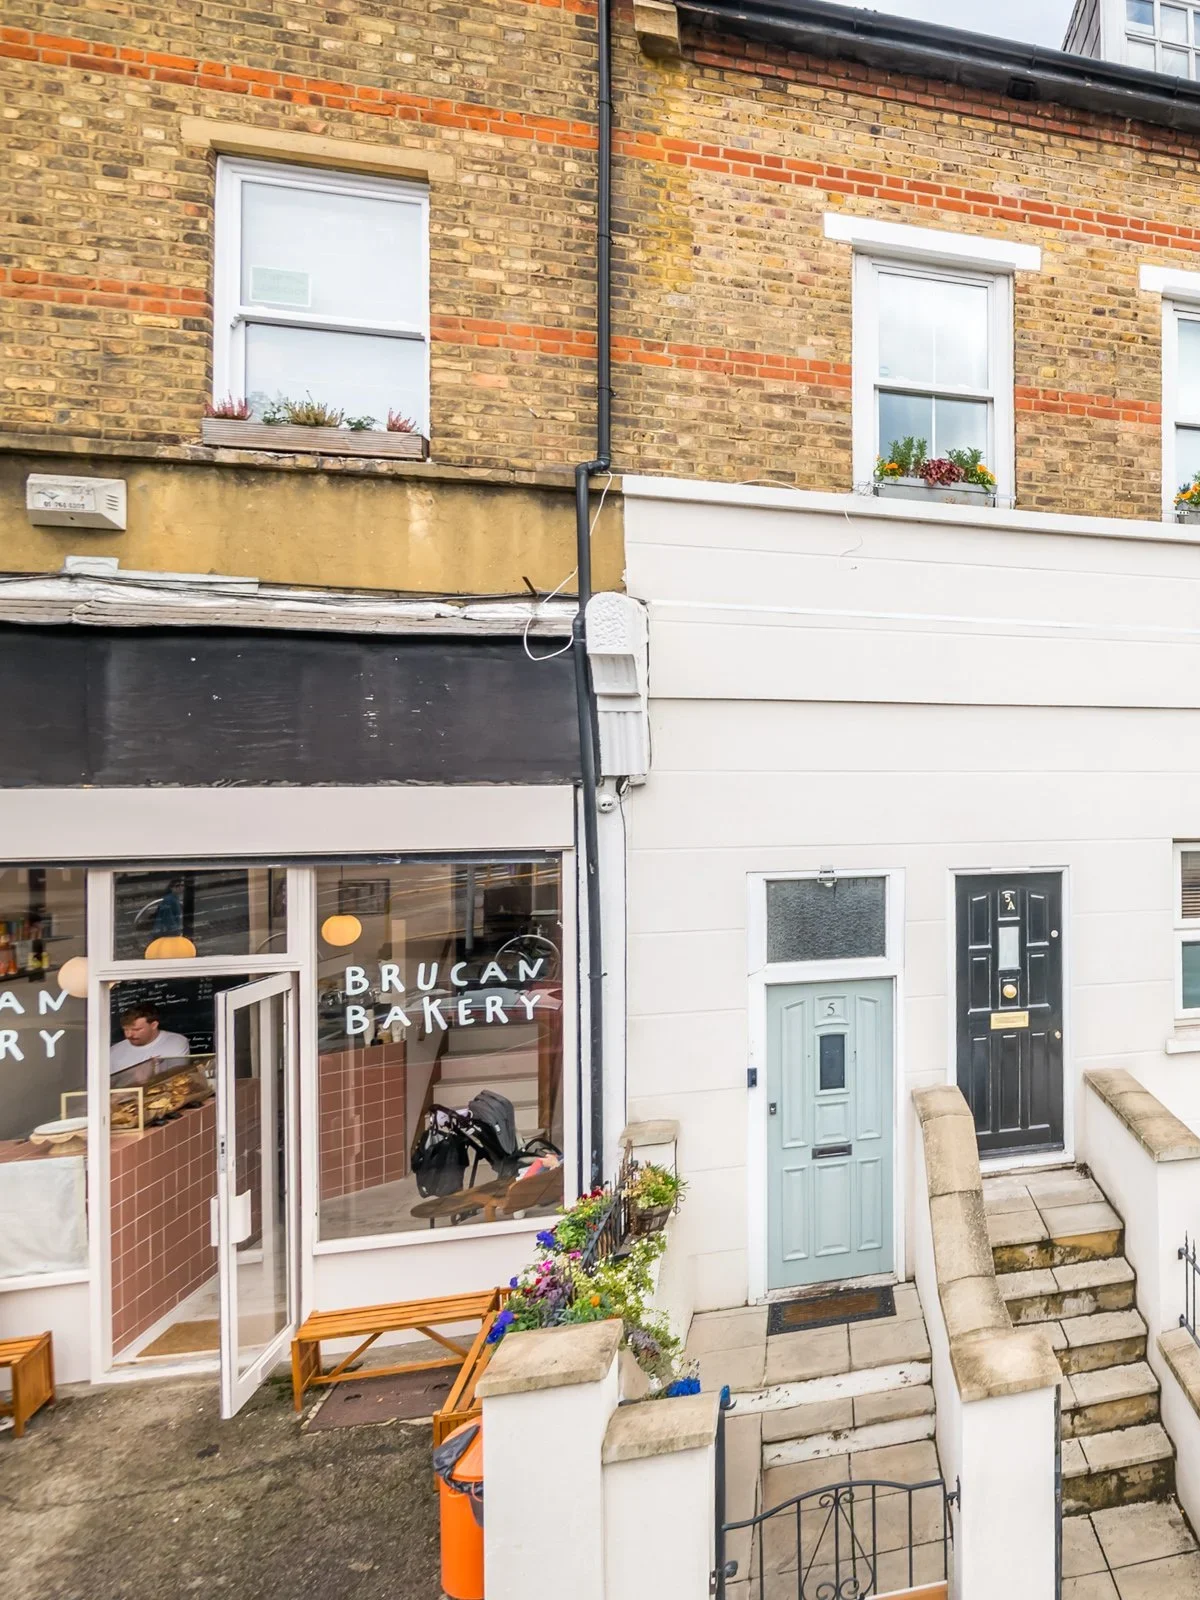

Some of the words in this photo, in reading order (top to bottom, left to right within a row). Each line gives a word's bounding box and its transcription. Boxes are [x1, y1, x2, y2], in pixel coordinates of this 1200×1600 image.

[345, 958, 544, 996] BRUCAN
[346, 996, 541, 1034] BAKERY
[827, 1002, 835, 1016] 5
